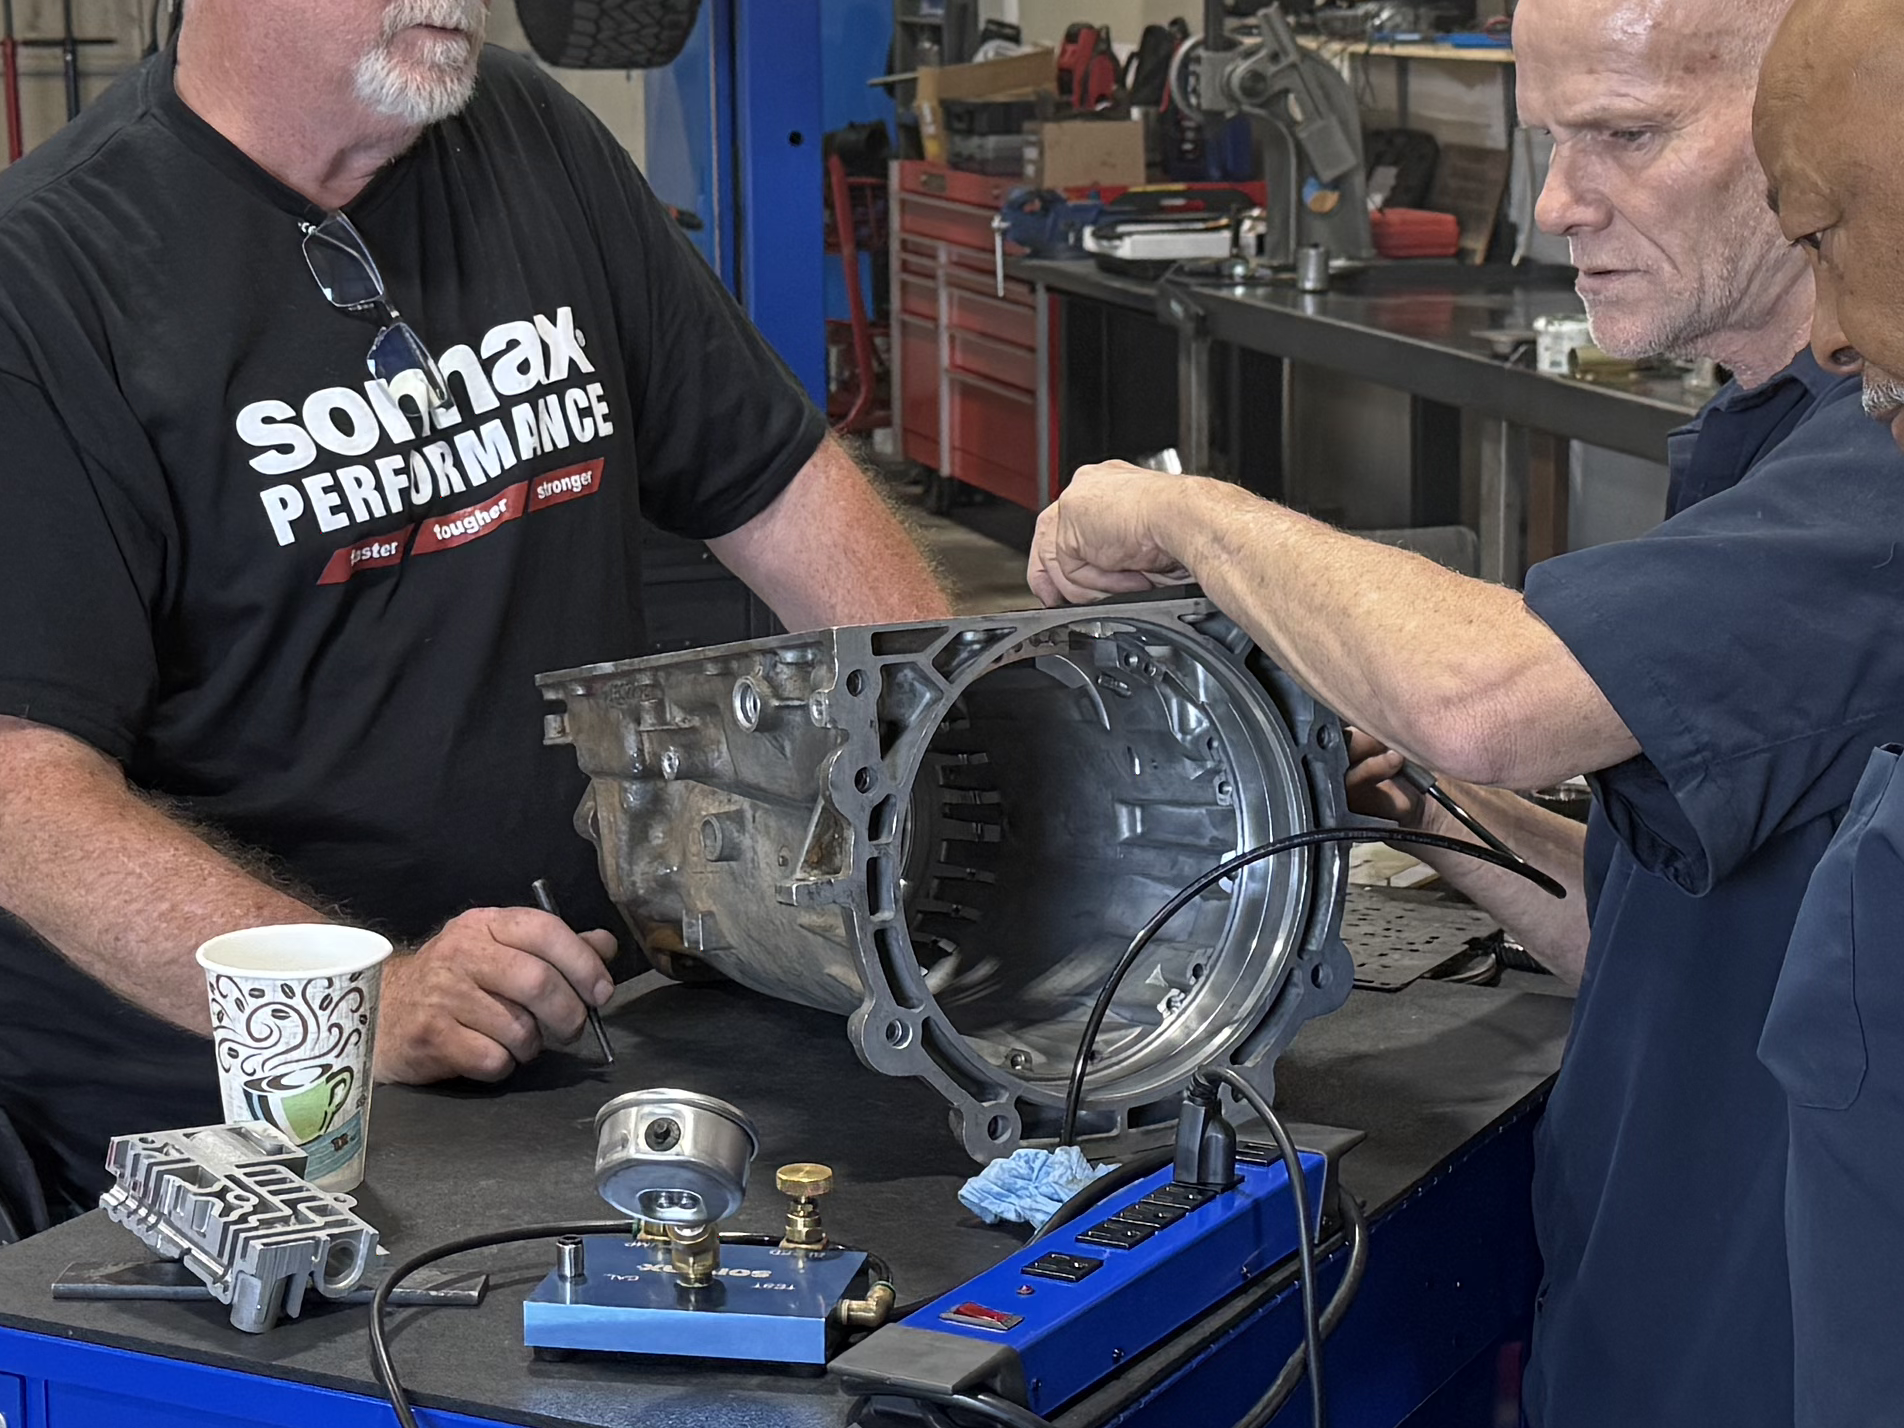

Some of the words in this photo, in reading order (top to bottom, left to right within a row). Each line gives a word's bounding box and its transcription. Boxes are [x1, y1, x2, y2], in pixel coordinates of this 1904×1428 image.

[235, 306, 595, 475] sonnax
[259, 383, 614, 546] PERFORMANCE
[433, 498, 508, 540] tougher
[536, 470, 593, 500] stronger
[637, 1263, 772, 1278] sonax
